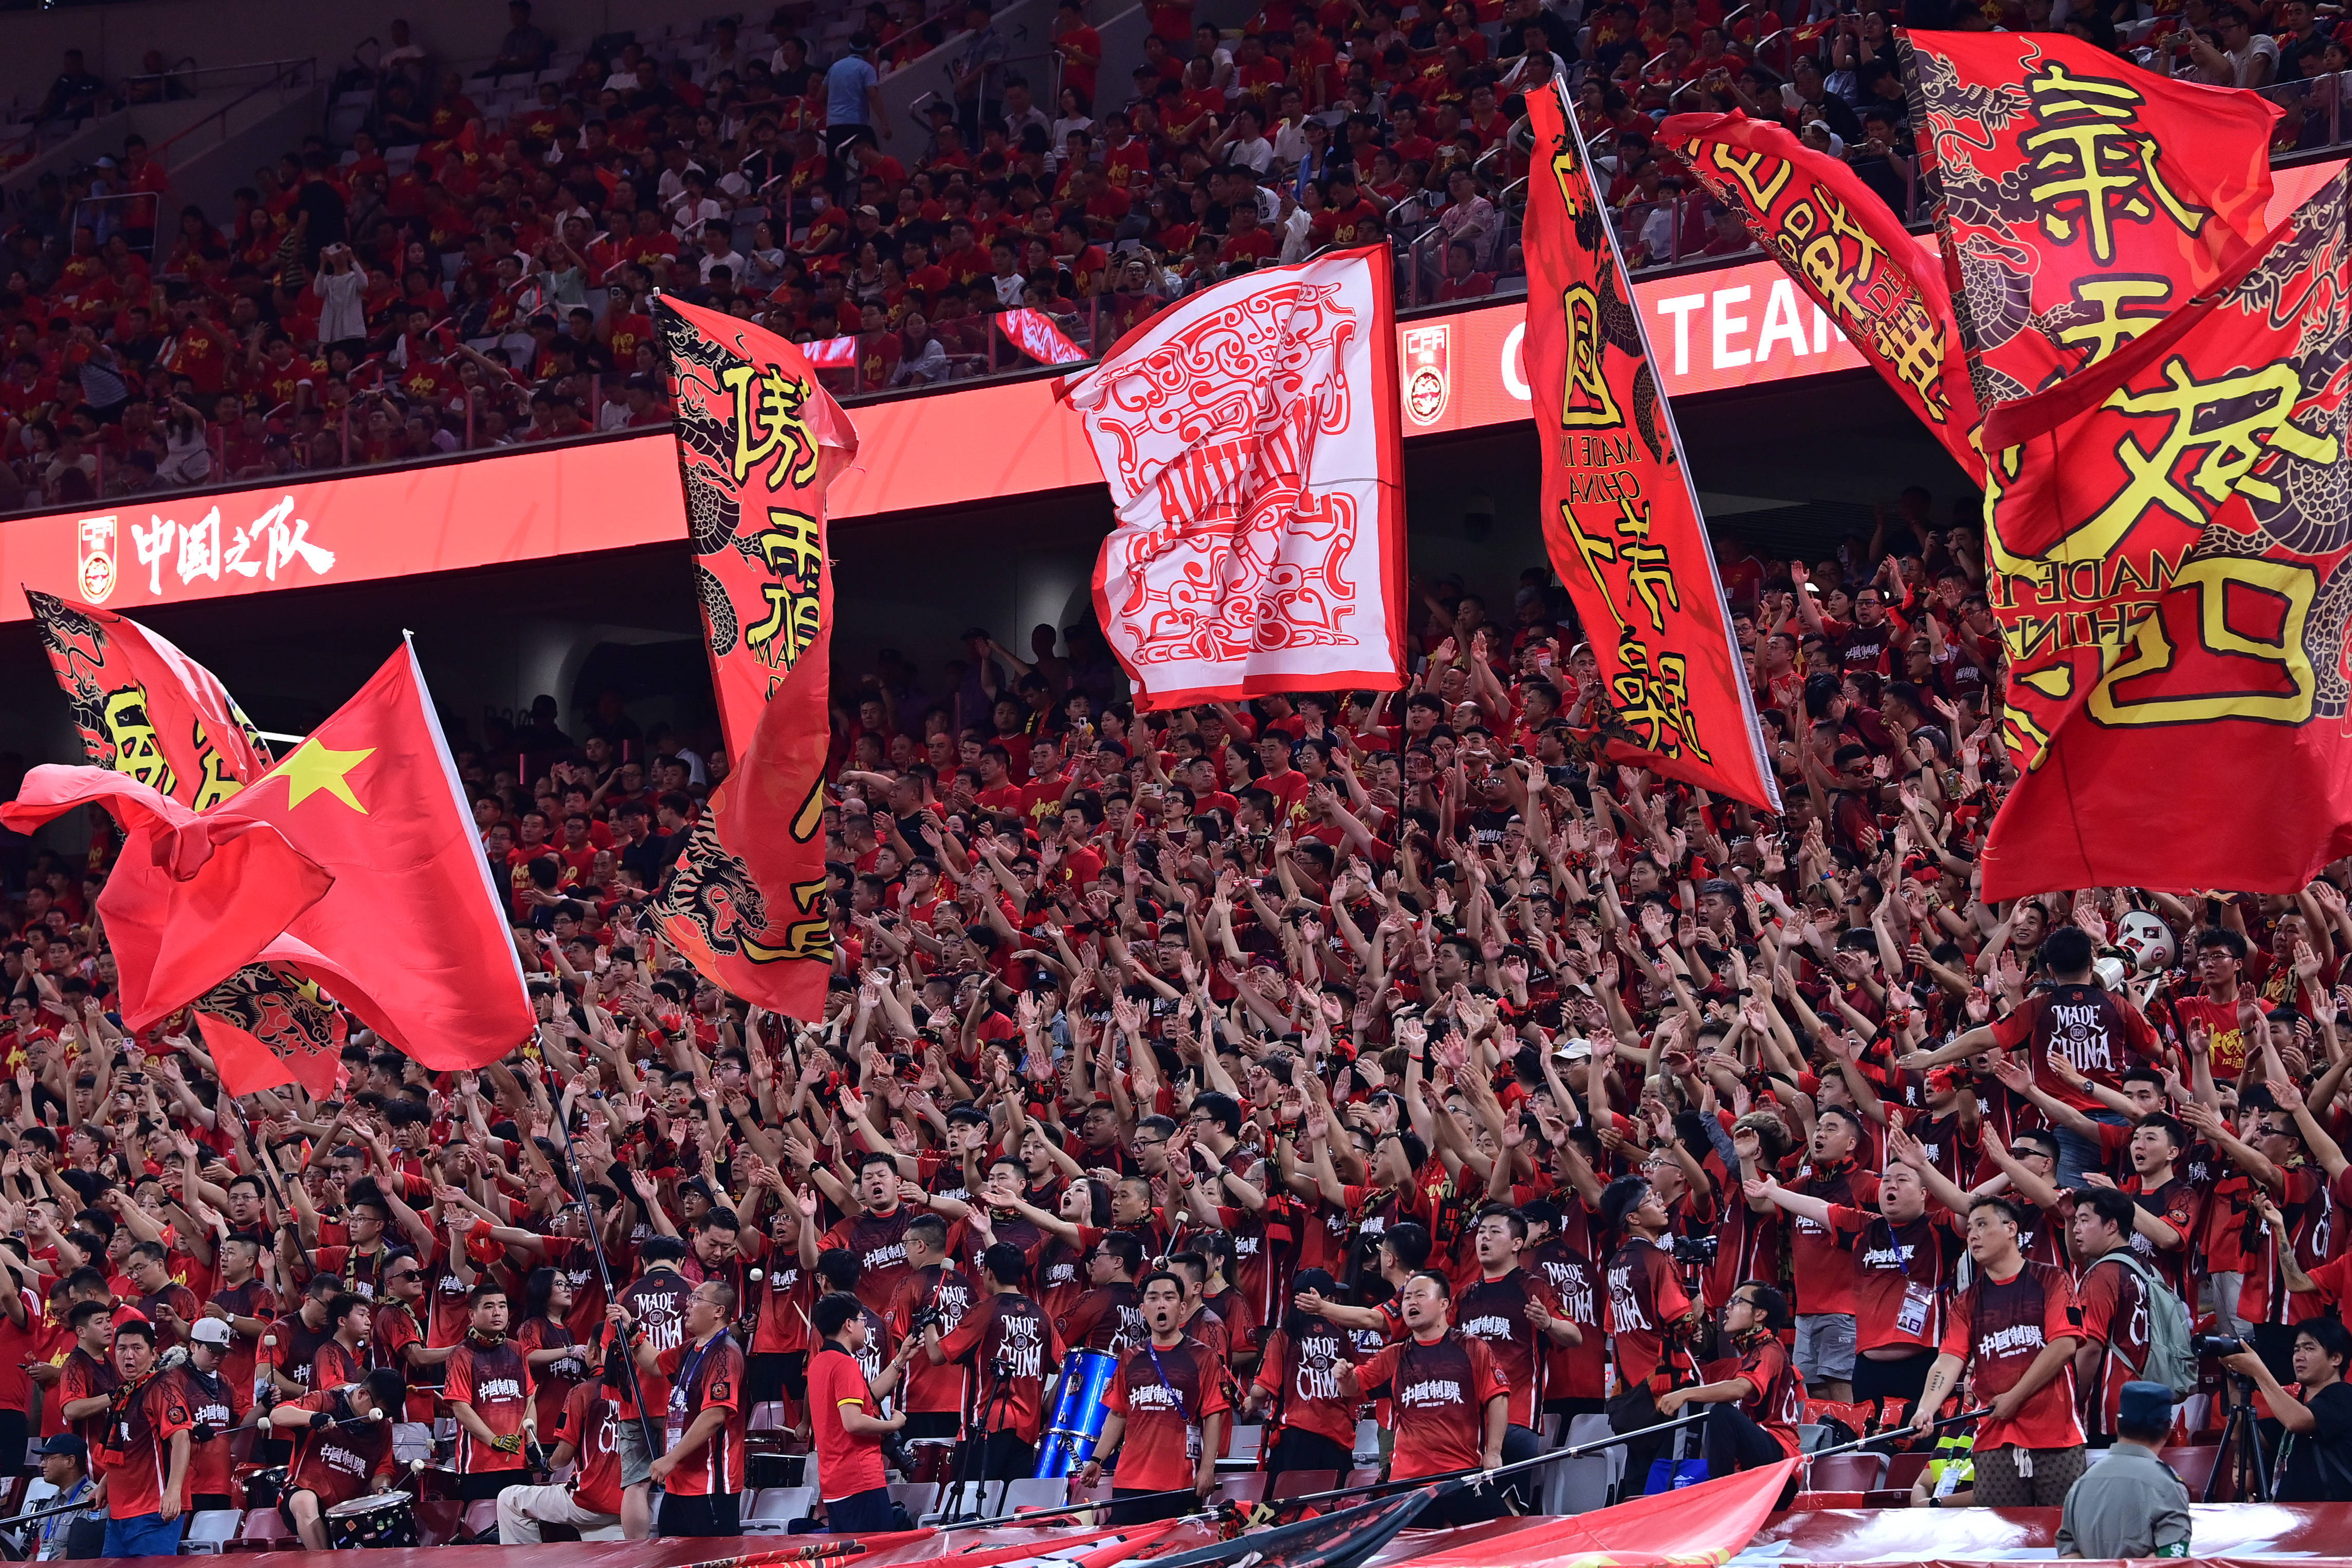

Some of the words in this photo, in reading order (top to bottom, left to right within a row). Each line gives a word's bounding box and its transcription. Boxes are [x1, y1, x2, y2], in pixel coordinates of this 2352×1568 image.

[1850, 266, 1902, 341] MADE
[1871, 284, 1924, 359] CHIN
[1408, 331, 1445, 354] CFA
[131, 495, 336, 595] 中国之队
[754, 635, 802, 672] MA
[2051, 1004, 2106, 1033] MADE
[2047, 1030, 2116, 1073] CHINA
[1542, 1262, 1590, 1287] MADE
[634, 1291, 680, 1320] MADE
[1558, 1288, 1597, 1327] HINA
[1610, 1292, 1652, 1337] HINA
[641, 1315, 683, 1352] HINA
[1000, 1314, 1042, 1343] MADE
[1978, 1325, 2046, 1361] 中國制躁
[1298, 1336, 1339, 1366] MADE
[1401, 1379, 1465, 1409] 中國制躁
[320, 1442, 366, 1479] 中國制躁
